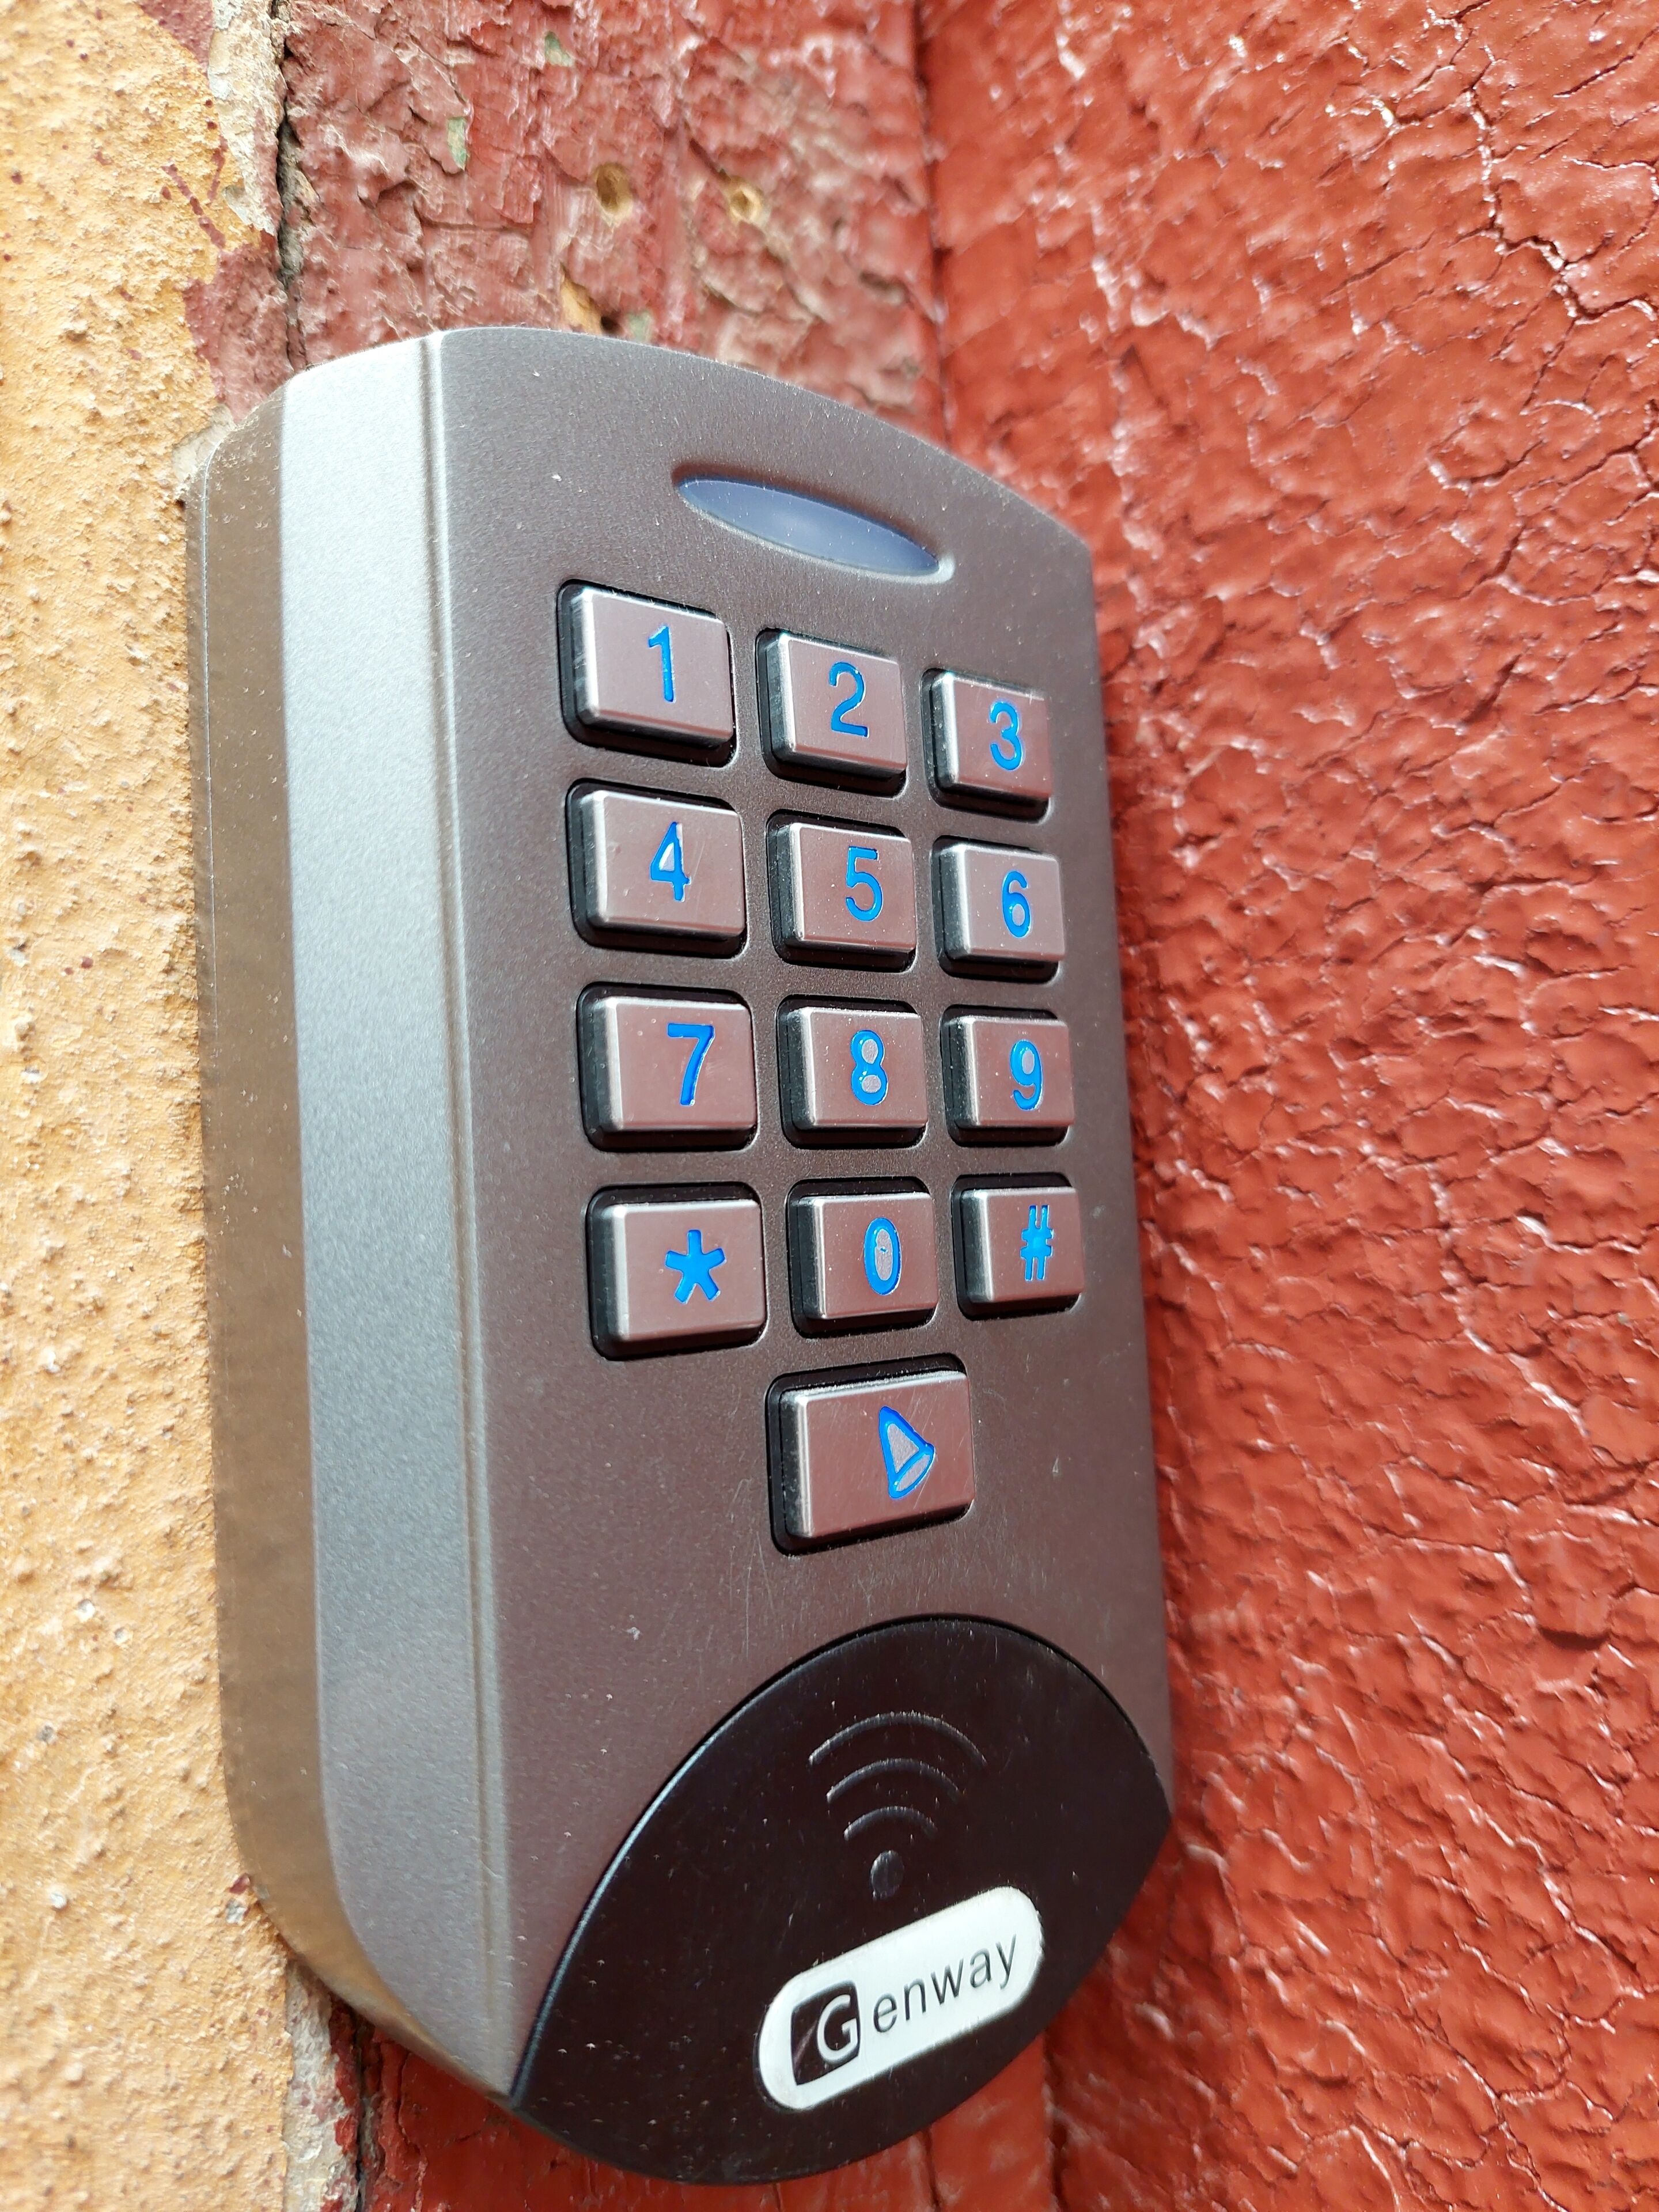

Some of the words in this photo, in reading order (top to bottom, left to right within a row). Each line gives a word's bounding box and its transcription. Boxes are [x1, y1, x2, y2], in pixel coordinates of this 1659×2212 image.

[647, 626, 675, 703] 1
[828, 661, 869, 738] 2
[989, 700, 1024, 771] 3
[649, 821, 690, 902] 4
[845, 846, 884, 922] 5
[1001, 870, 1031, 938] 6
[666, 1022, 715, 1106] 7
[849, 1029, 888, 1106] 8
[1009, 1039, 1043, 1111] 9
[863, 1217, 902, 1296] 0
[1020, 1204, 1054, 1281] #
[815, 1934, 1018, 2065] Genway
